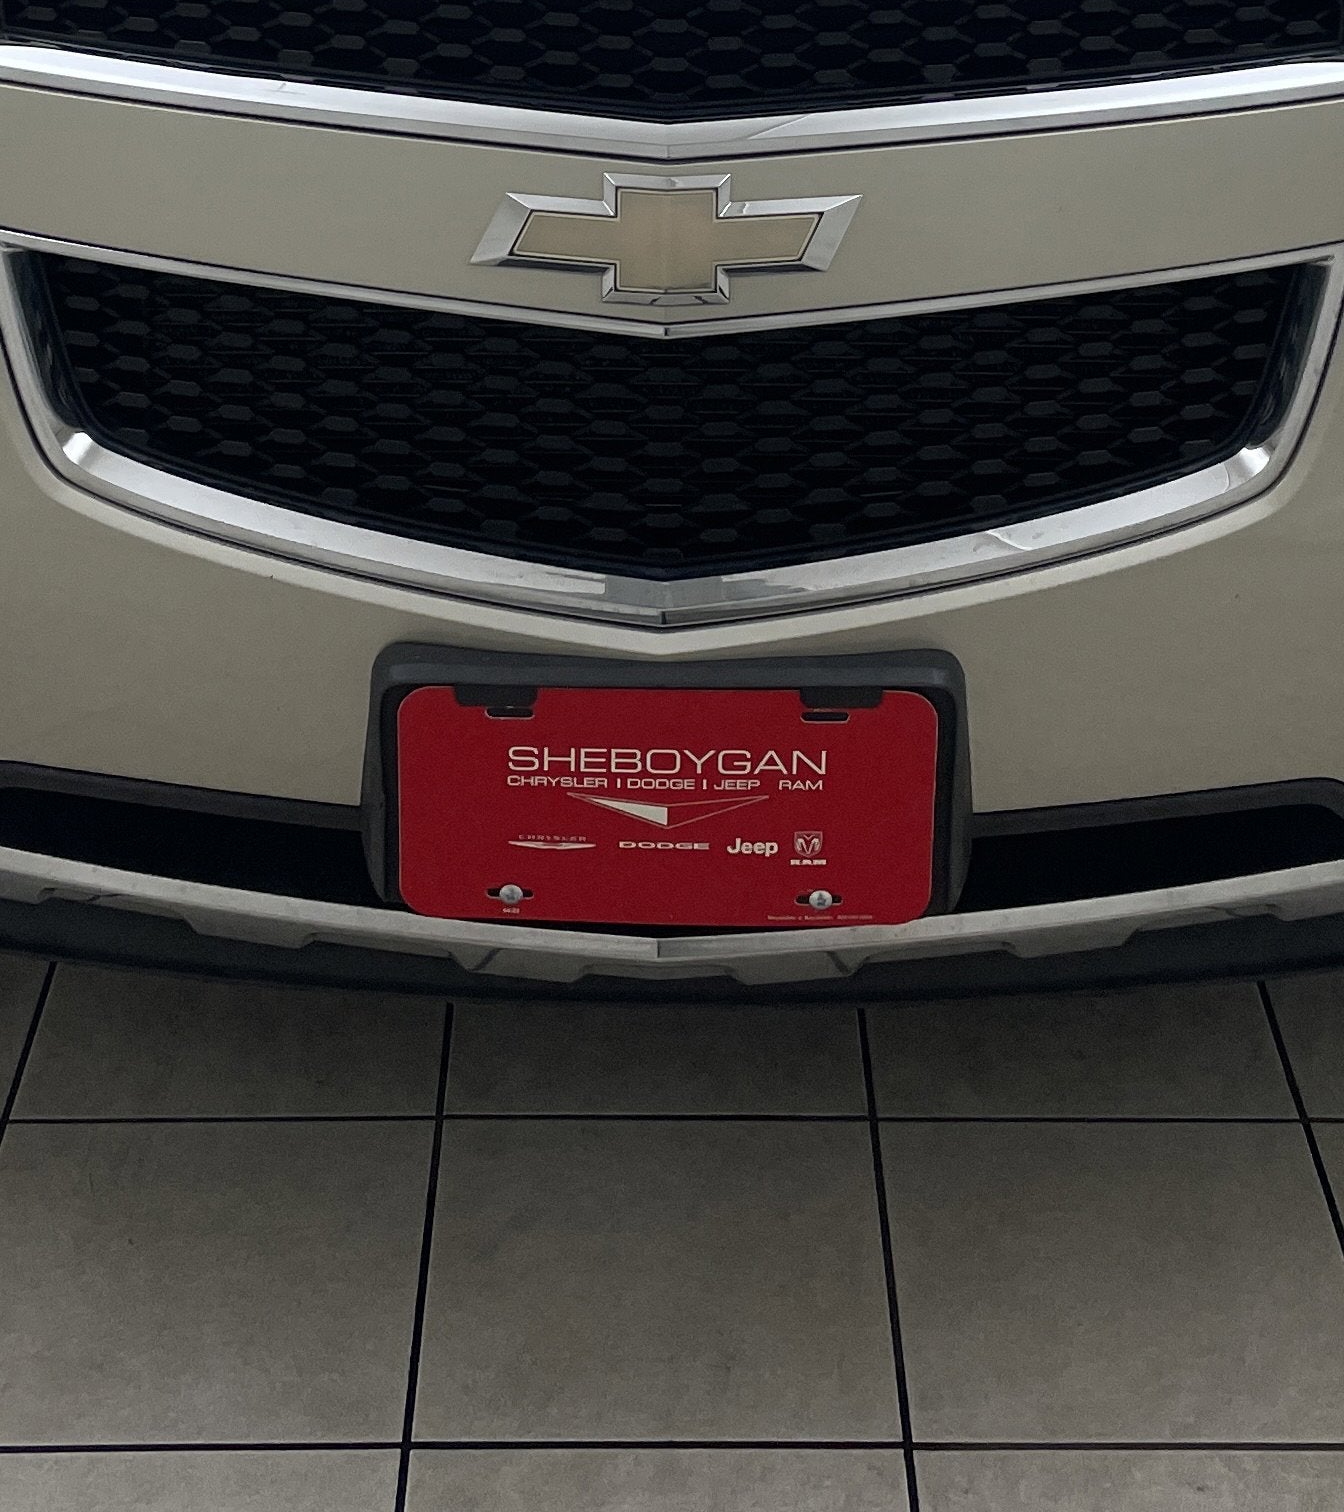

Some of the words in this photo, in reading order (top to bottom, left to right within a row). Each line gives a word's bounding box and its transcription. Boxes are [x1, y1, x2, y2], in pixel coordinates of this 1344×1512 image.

[508, 746, 828, 775] SHEBOYGAN
[507, 775, 608, 789] CHRYSLER
[627, 778, 696, 790] DODGE
[713, 779, 761, 791] JEEP
[778, 779, 824, 791] RAM
[619, 841, 710, 850] DODGE
[727, 837, 779, 857] Jeep
